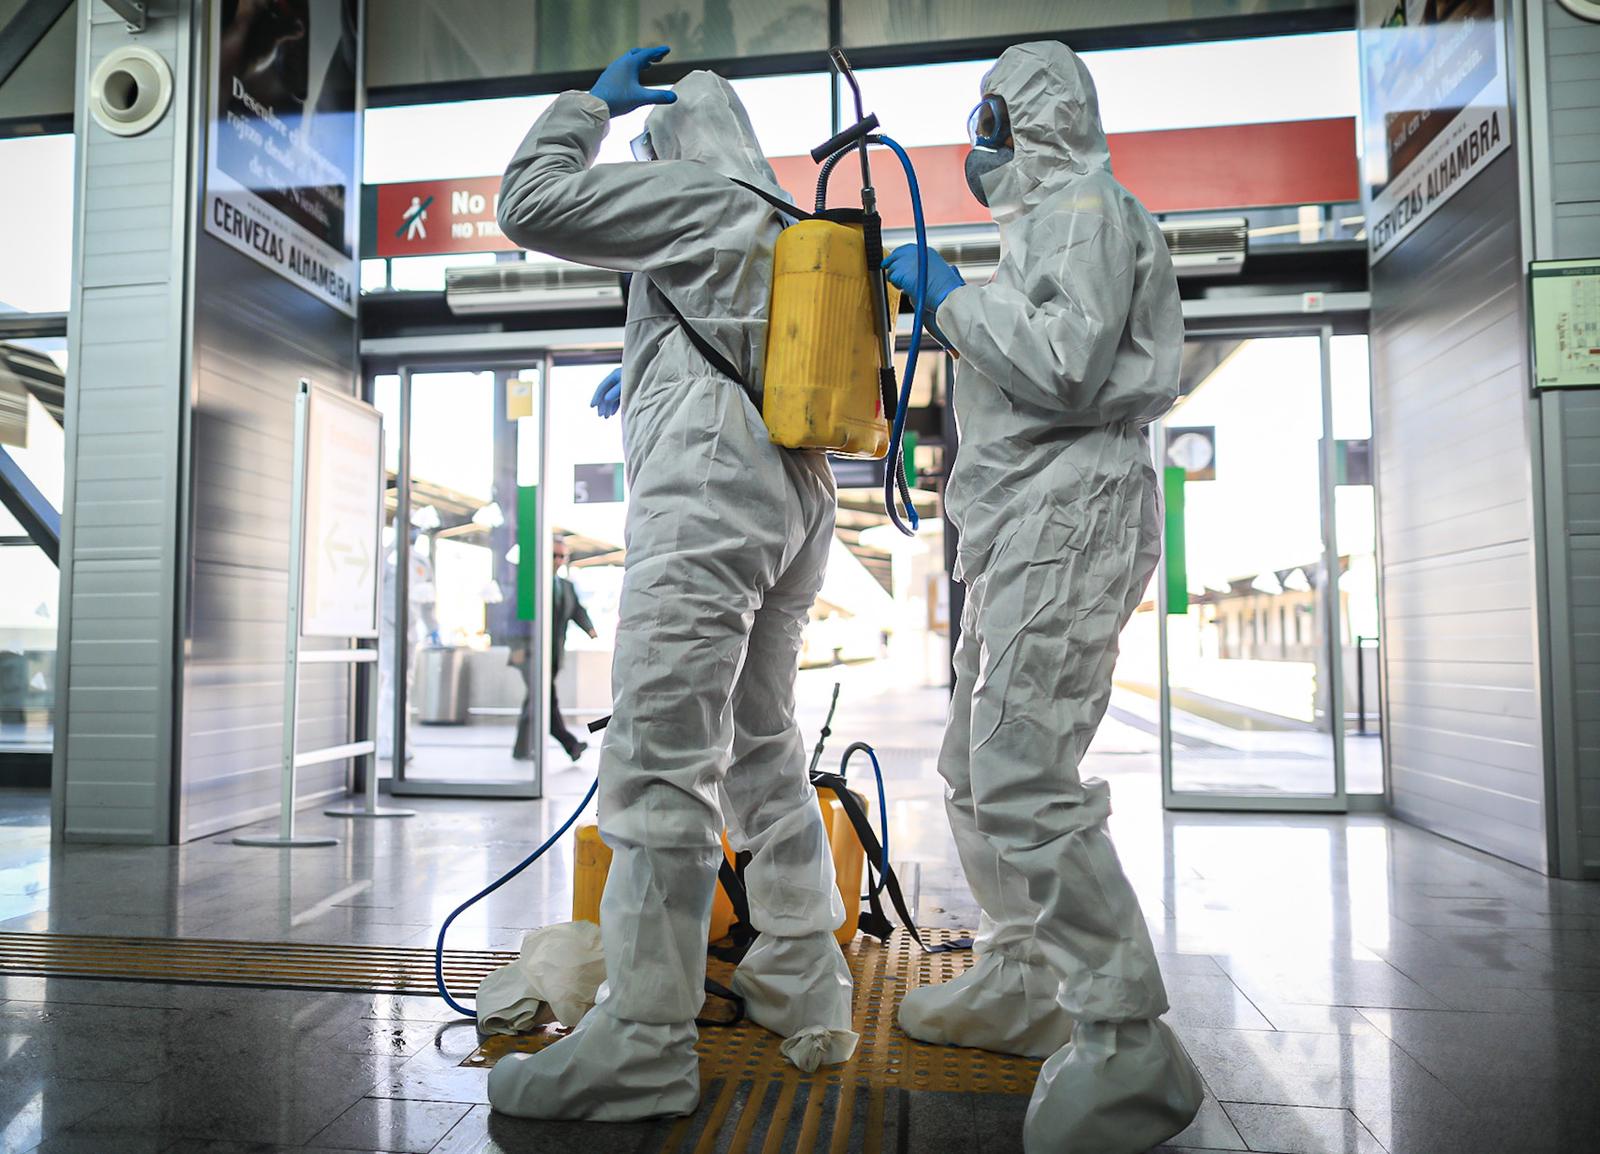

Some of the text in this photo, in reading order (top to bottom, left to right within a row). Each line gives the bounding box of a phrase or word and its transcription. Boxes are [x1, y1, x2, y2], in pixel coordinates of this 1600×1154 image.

[452, 190, 485, 216] No
[1373, 183, 1423, 252] CERVEZAS
[1427, 110, 1500, 205] ALHAMBRA
[214, 197, 284, 264] CERVEZAS
[288, 245, 352, 306] ALHAMBRA
[451, 222, 473, 238] NO
